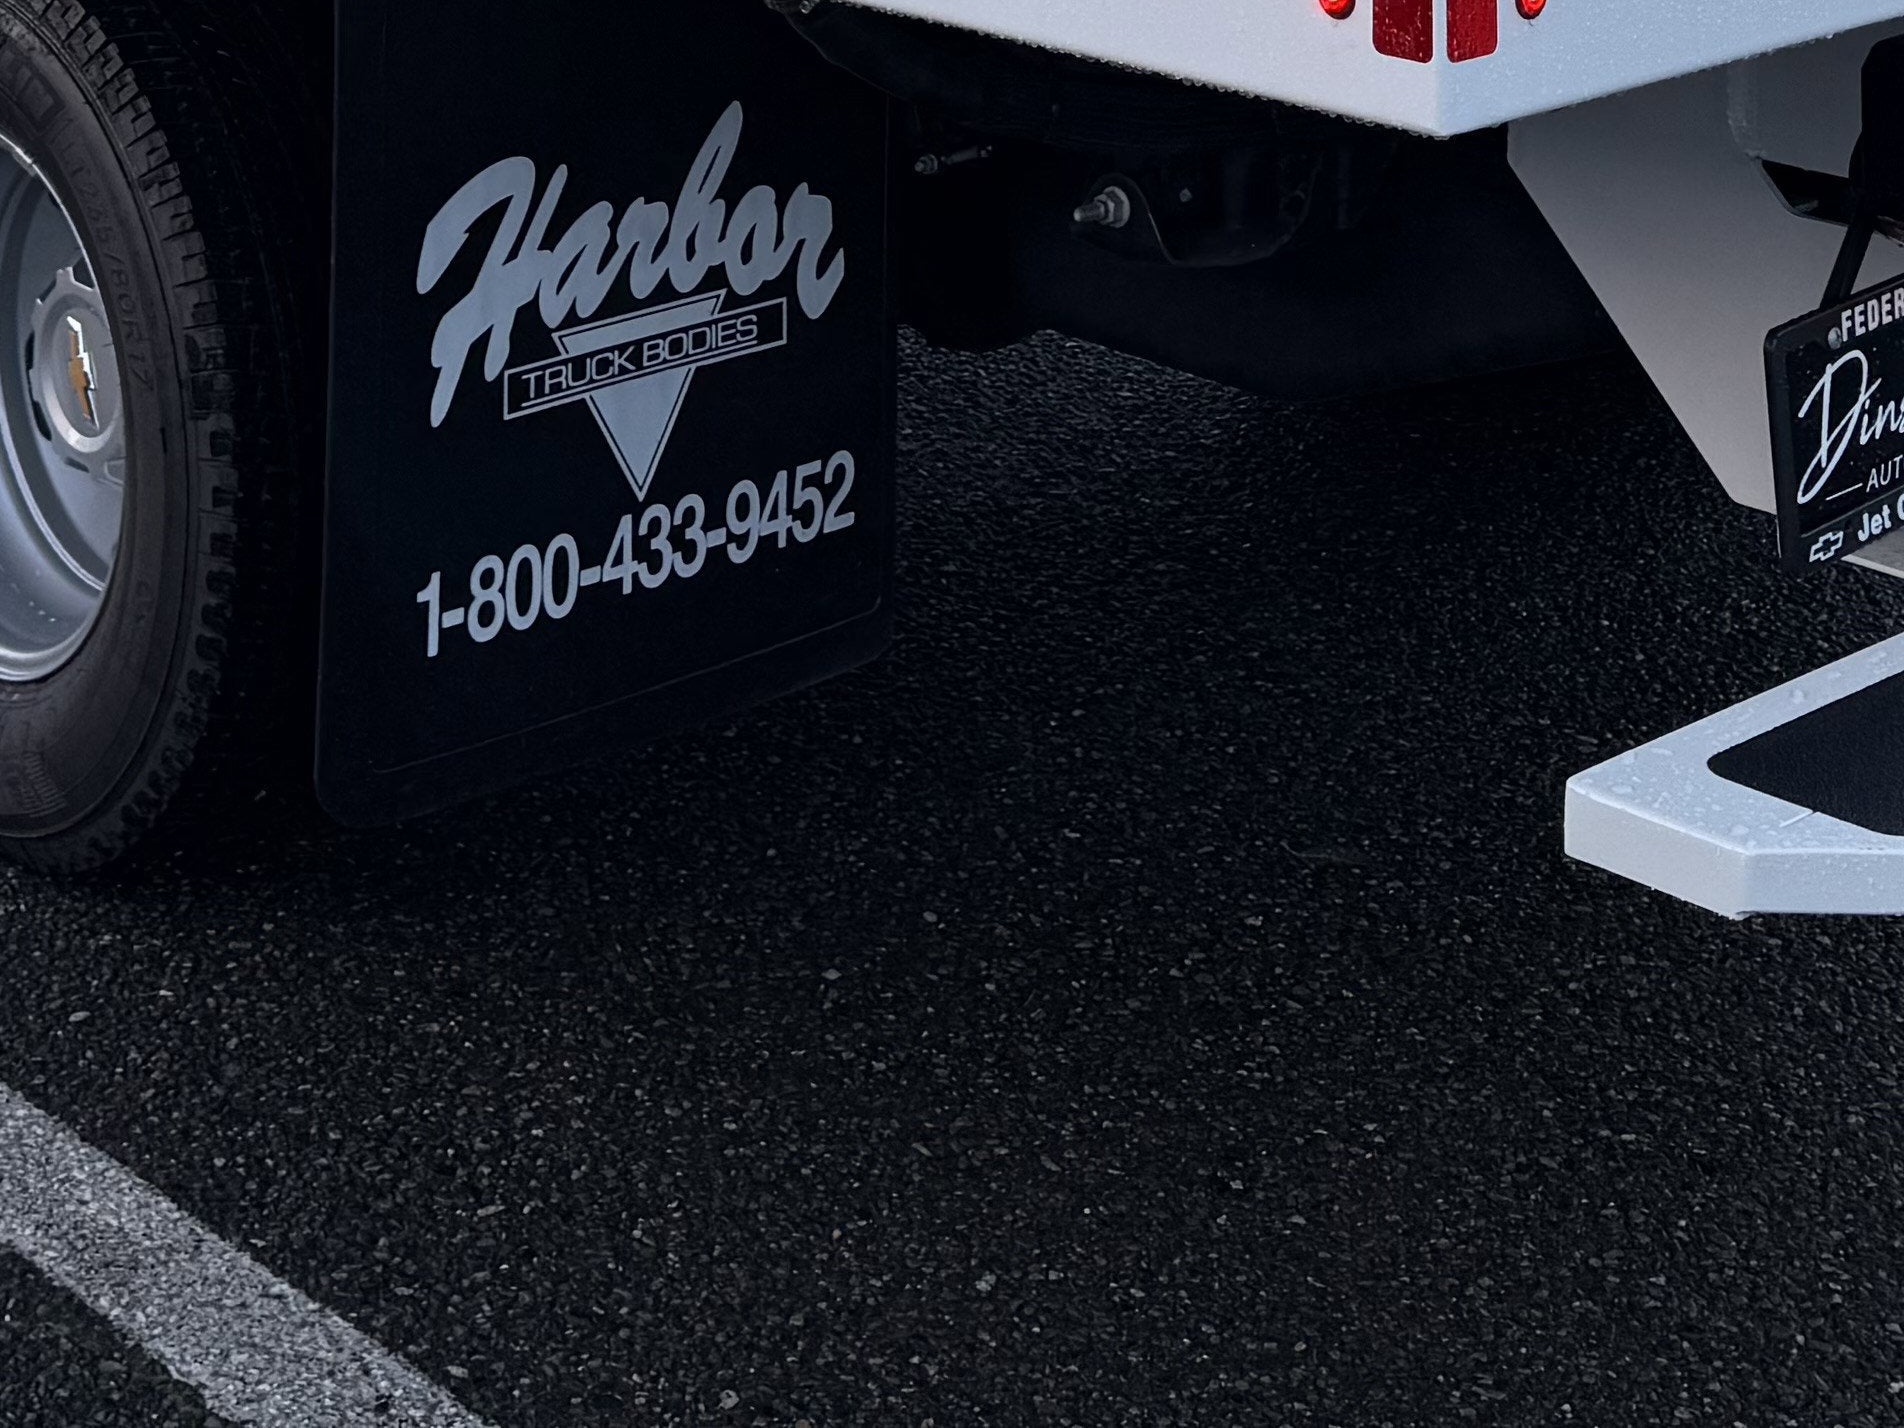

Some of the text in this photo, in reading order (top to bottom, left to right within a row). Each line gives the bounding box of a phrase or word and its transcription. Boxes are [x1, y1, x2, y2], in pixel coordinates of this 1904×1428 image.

[416, 100, 844, 427] Harbor
[521, 314, 759, 400] TRUCK BODIES
[416, 450, 856, 657] 1-800-433-9452
[1857, 503, 1892, 543] Jet
